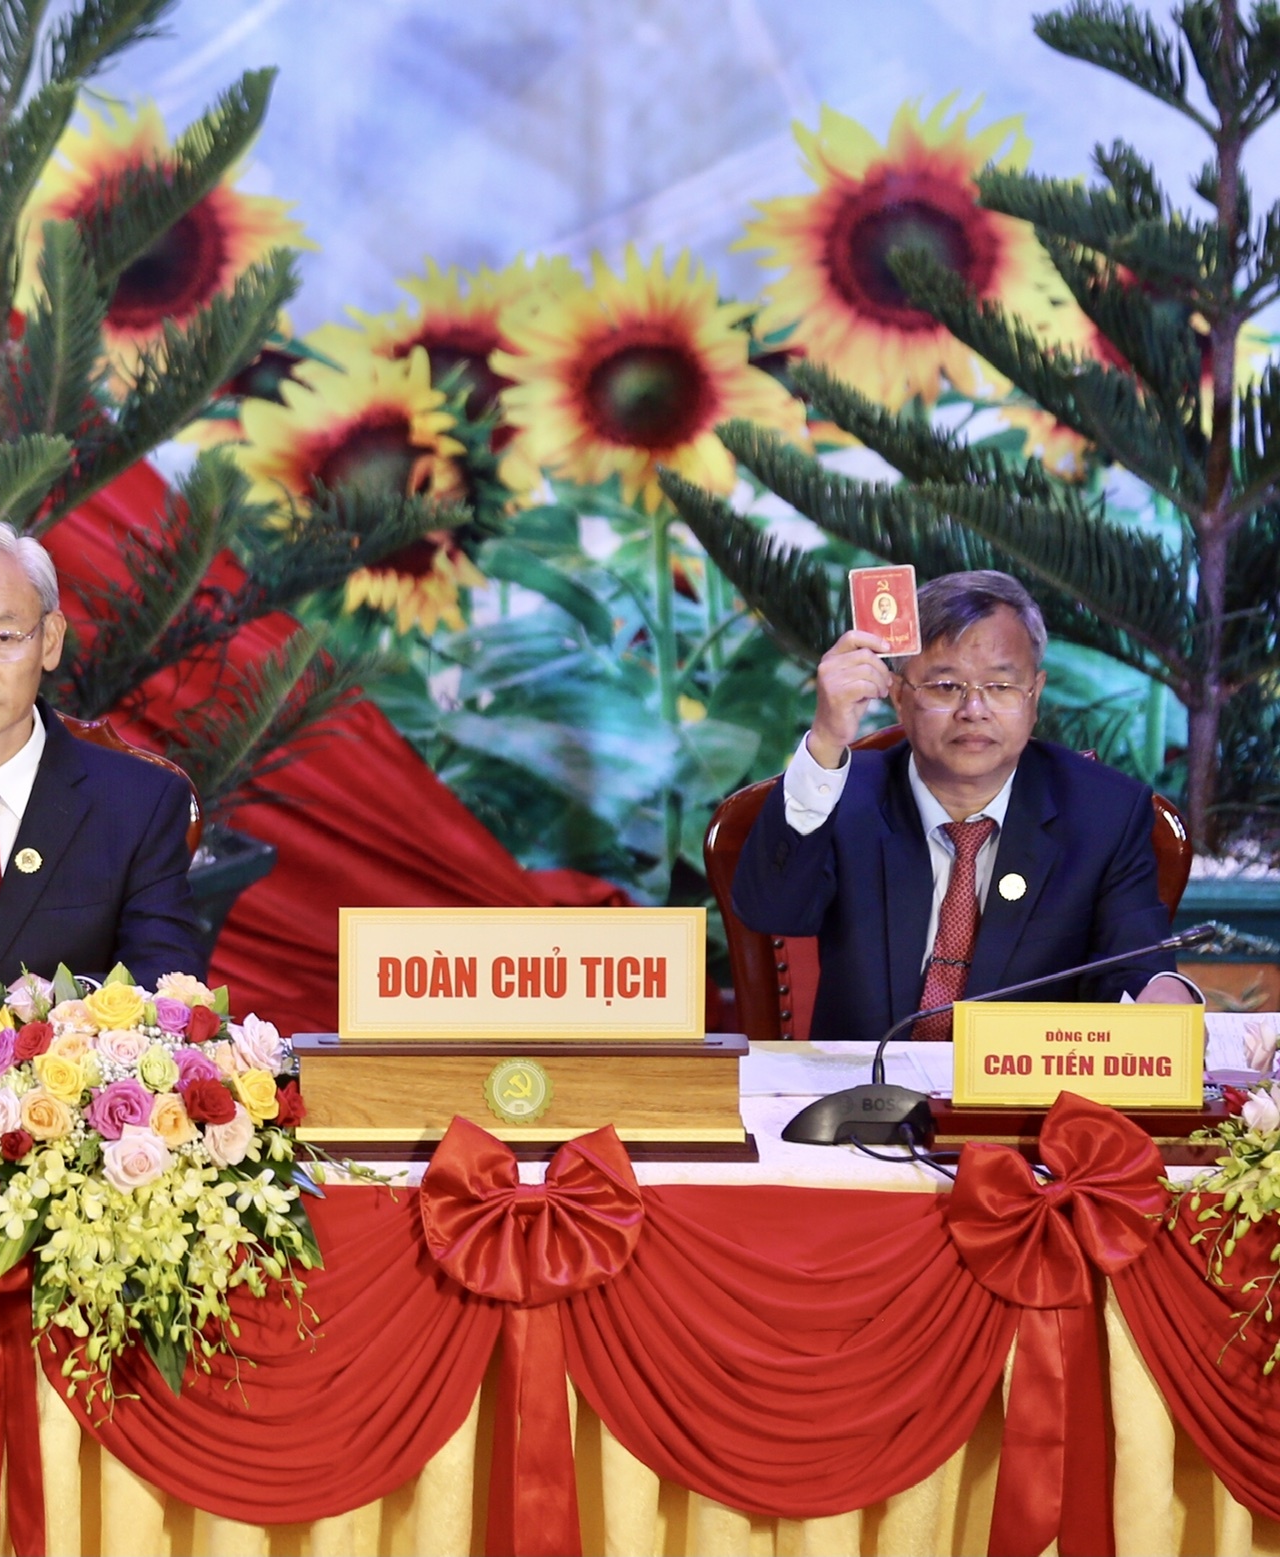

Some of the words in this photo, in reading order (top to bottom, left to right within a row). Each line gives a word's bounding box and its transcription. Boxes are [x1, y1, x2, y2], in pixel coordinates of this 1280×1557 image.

[377, 950, 477, 998] ĐOÀN
[492, 946, 567, 999] CHỦ
[580, 956, 666, 1006] TỊCH
[1087, 1031, 1110, 1042] CHÍ
[984, 1054, 1032, 1076] CAO
[1041, 1049, 1094, 1076] TIẾN
[1104, 1053, 1172, 1077] DŨNG
